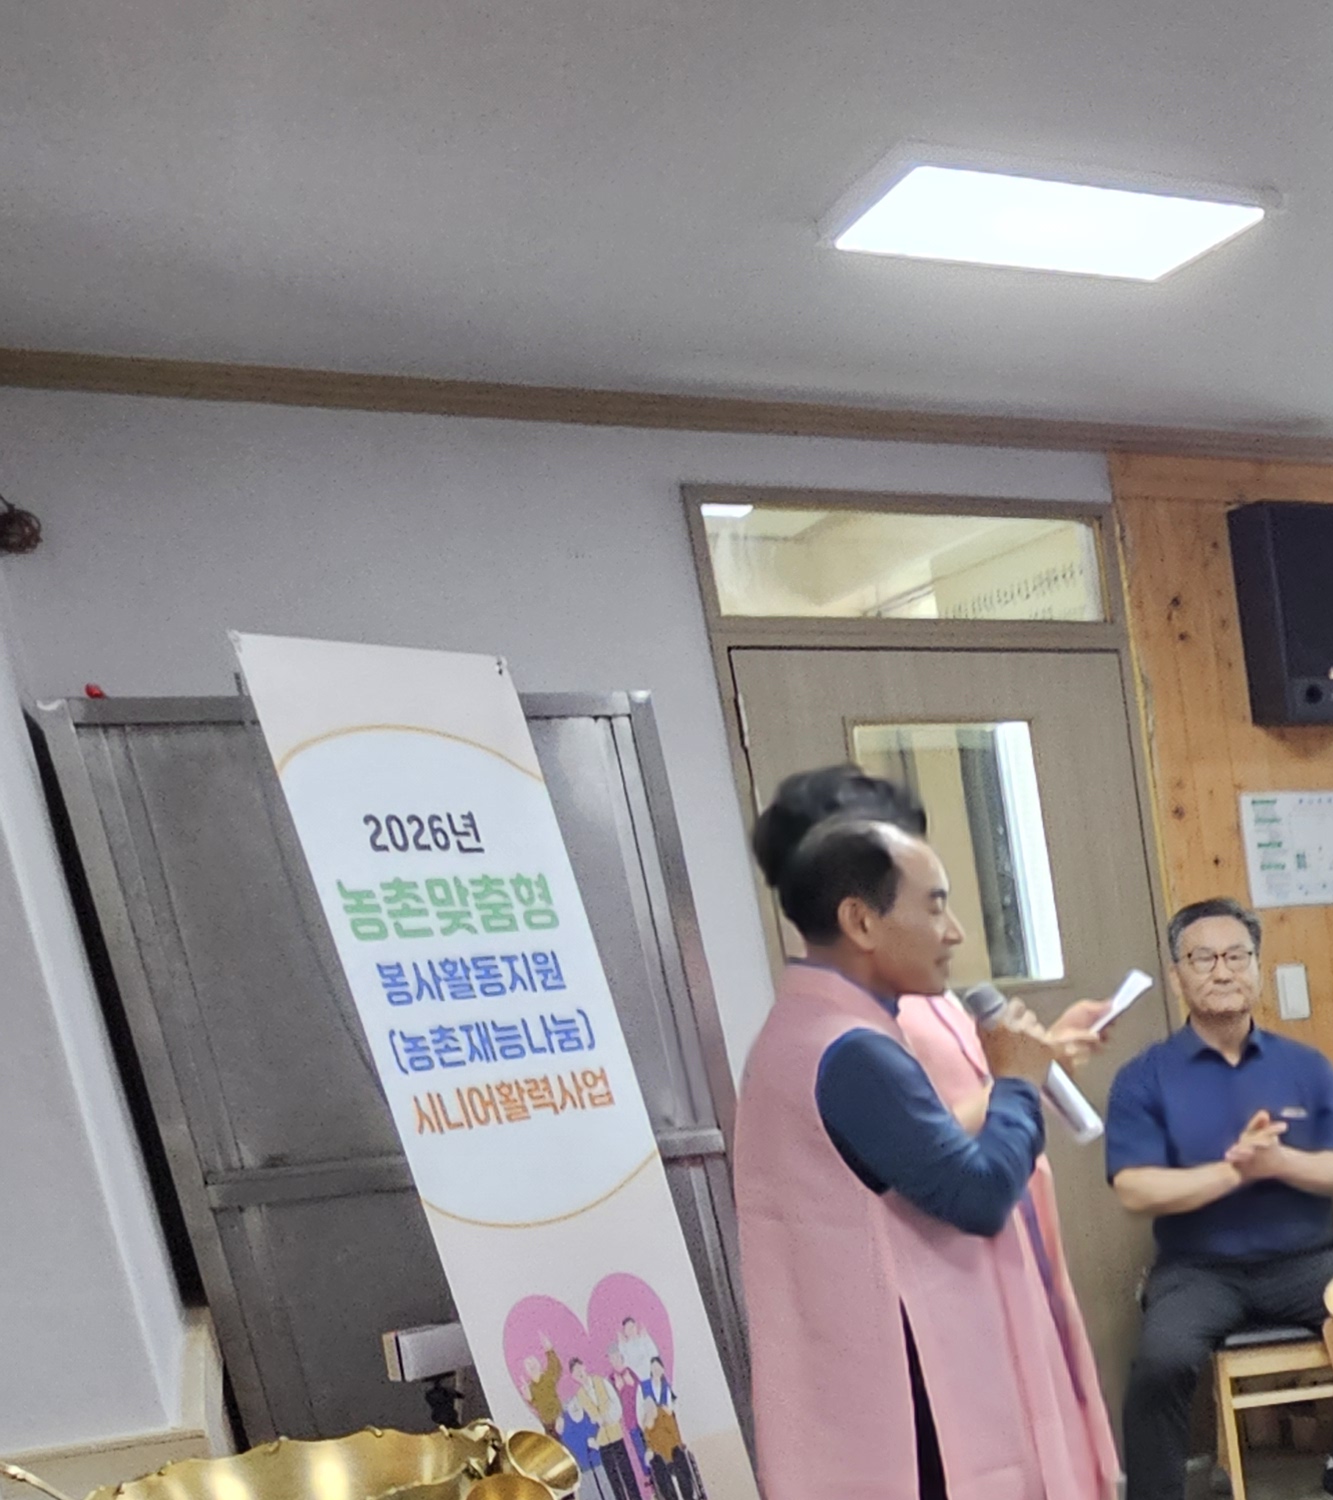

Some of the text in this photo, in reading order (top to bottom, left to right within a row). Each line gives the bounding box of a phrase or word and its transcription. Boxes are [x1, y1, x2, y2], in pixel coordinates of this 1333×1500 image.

[363, 811, 485, 853] 2026년
[336, 872, 560, 942] 농촌맞춤형
[376, 950, 567, 1007] 봉사활동지원
[388, 1008, 596, 1075] (농촌재능나눔)
[412, 1066, 616, 1135] 시니어활력사업
